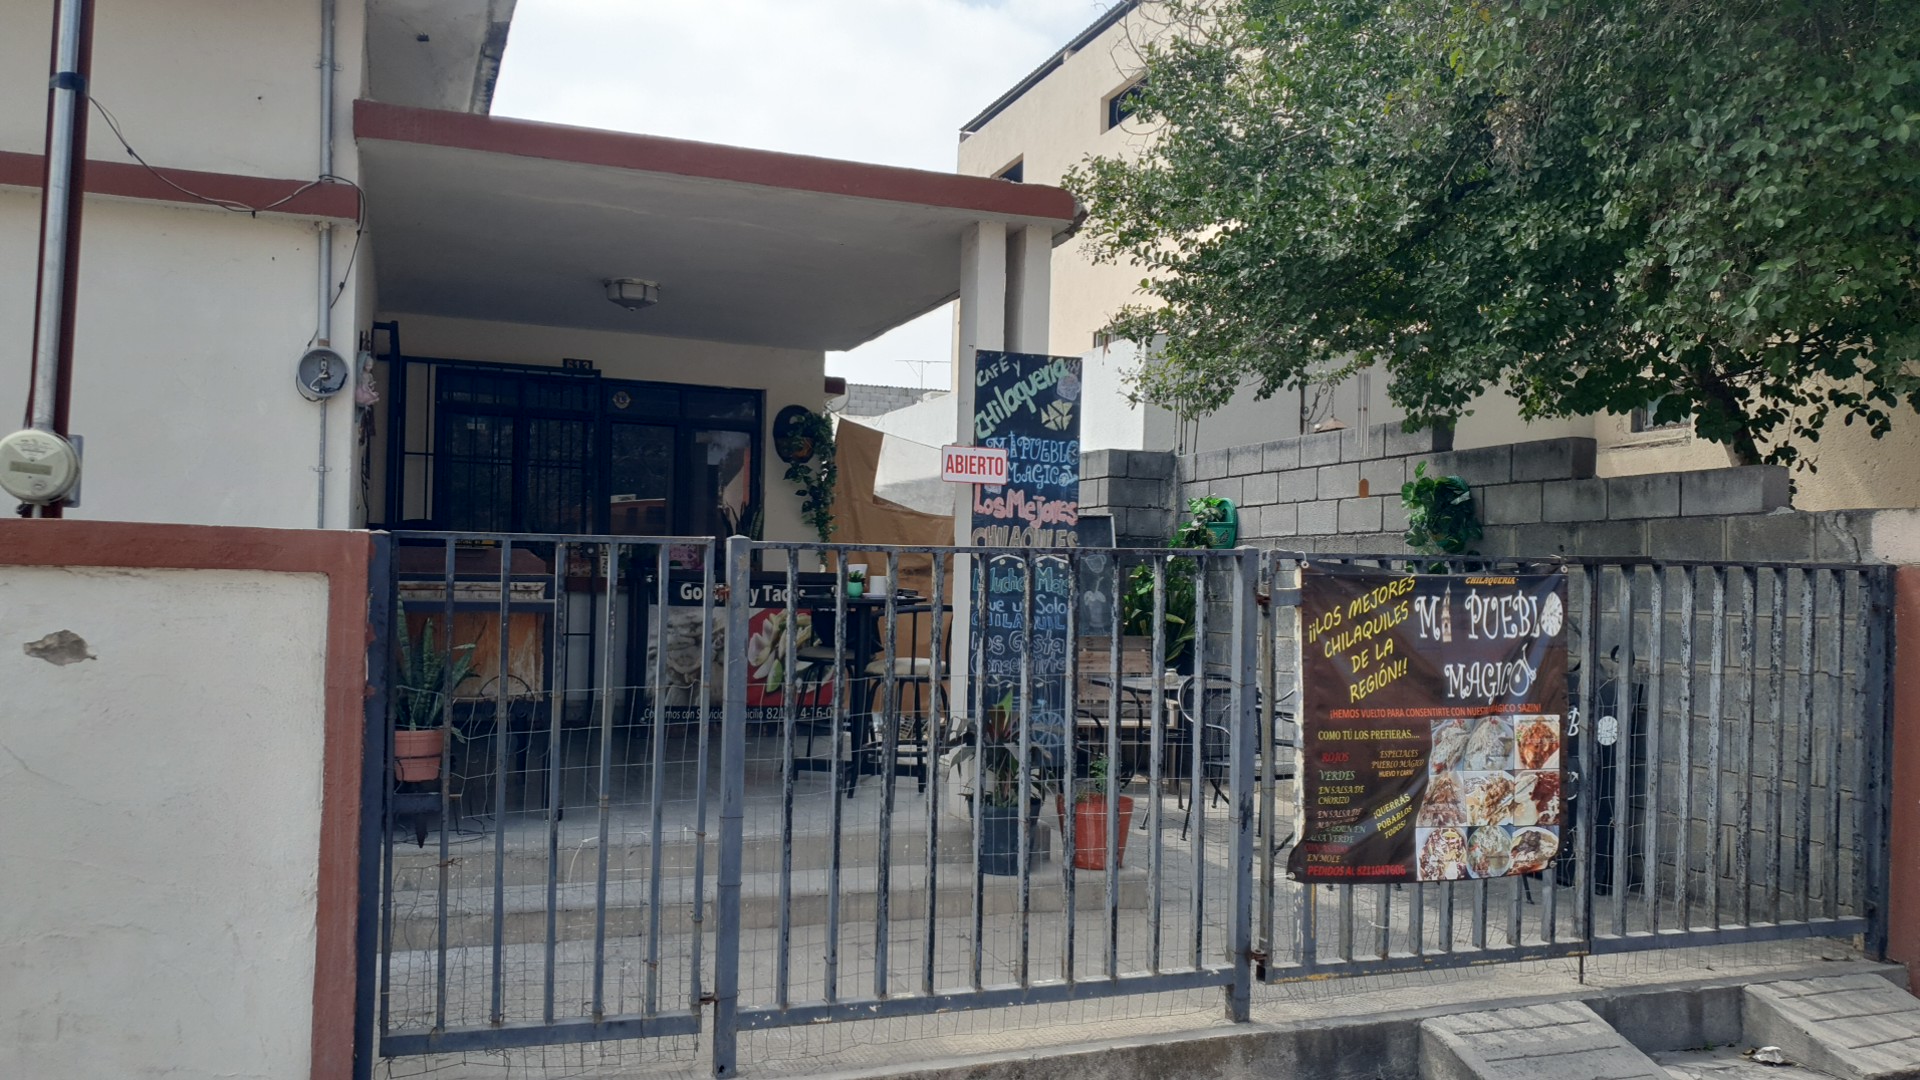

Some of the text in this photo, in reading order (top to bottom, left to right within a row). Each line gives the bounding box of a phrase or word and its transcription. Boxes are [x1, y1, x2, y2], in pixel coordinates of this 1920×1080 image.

[976, 354, 1010, 388] CAFÉ
[945, 454, 1004, 476] ABIERTO
[973, 483, 1079, 530] Los Mejores
[749, 588, 759, 607] y
[762, 585, 807, 602] Tacs
[1035, 594, 1067, 615] Solo
[1348, 575, 1416, 620] MEJORES
[1464, 587, 1564, 641] PUEBLO
[1324, 600, 1410, 660] CHILAQUILES
[1008, 629, 1065, 655] Gsta
[1352, 638, 1395, 674] DE LA
[1349, 656, 1409, 704] REGIÓN!!
[1443, 643, 1538, 706] MAGICO
[682, 708, 695, 720] con
[1361, 708, 1386, 719] VUELTO
[1386, 707, 1405, 718] PARA
[1406, 706, 1450, 718] CONSENTIRTE
[1450, 706, 1466, 717] CON
[1318, 731, 1341, 741] COMO
[1343, 728, 1353, 741] TÚ
[1353, 730, 1369, 740] LOS
[1321, 752, 1350, 764] ROJOS
[1380, 749, 1419, 759] ESPECIALES
[1371, 759, 1398, 769] PUEBLO
[1319, 769, 1356, 781] VERDES
[1378, 770, 1396, 778] HUEVO
[1318, 784, 1366, 795] EN SALSA DE
[1318, 795, 1350, 806] CHORIZO
[1318, 854, 1342, 864] MOLE
[1307, 865, 1345, 877] PEDIDOS
